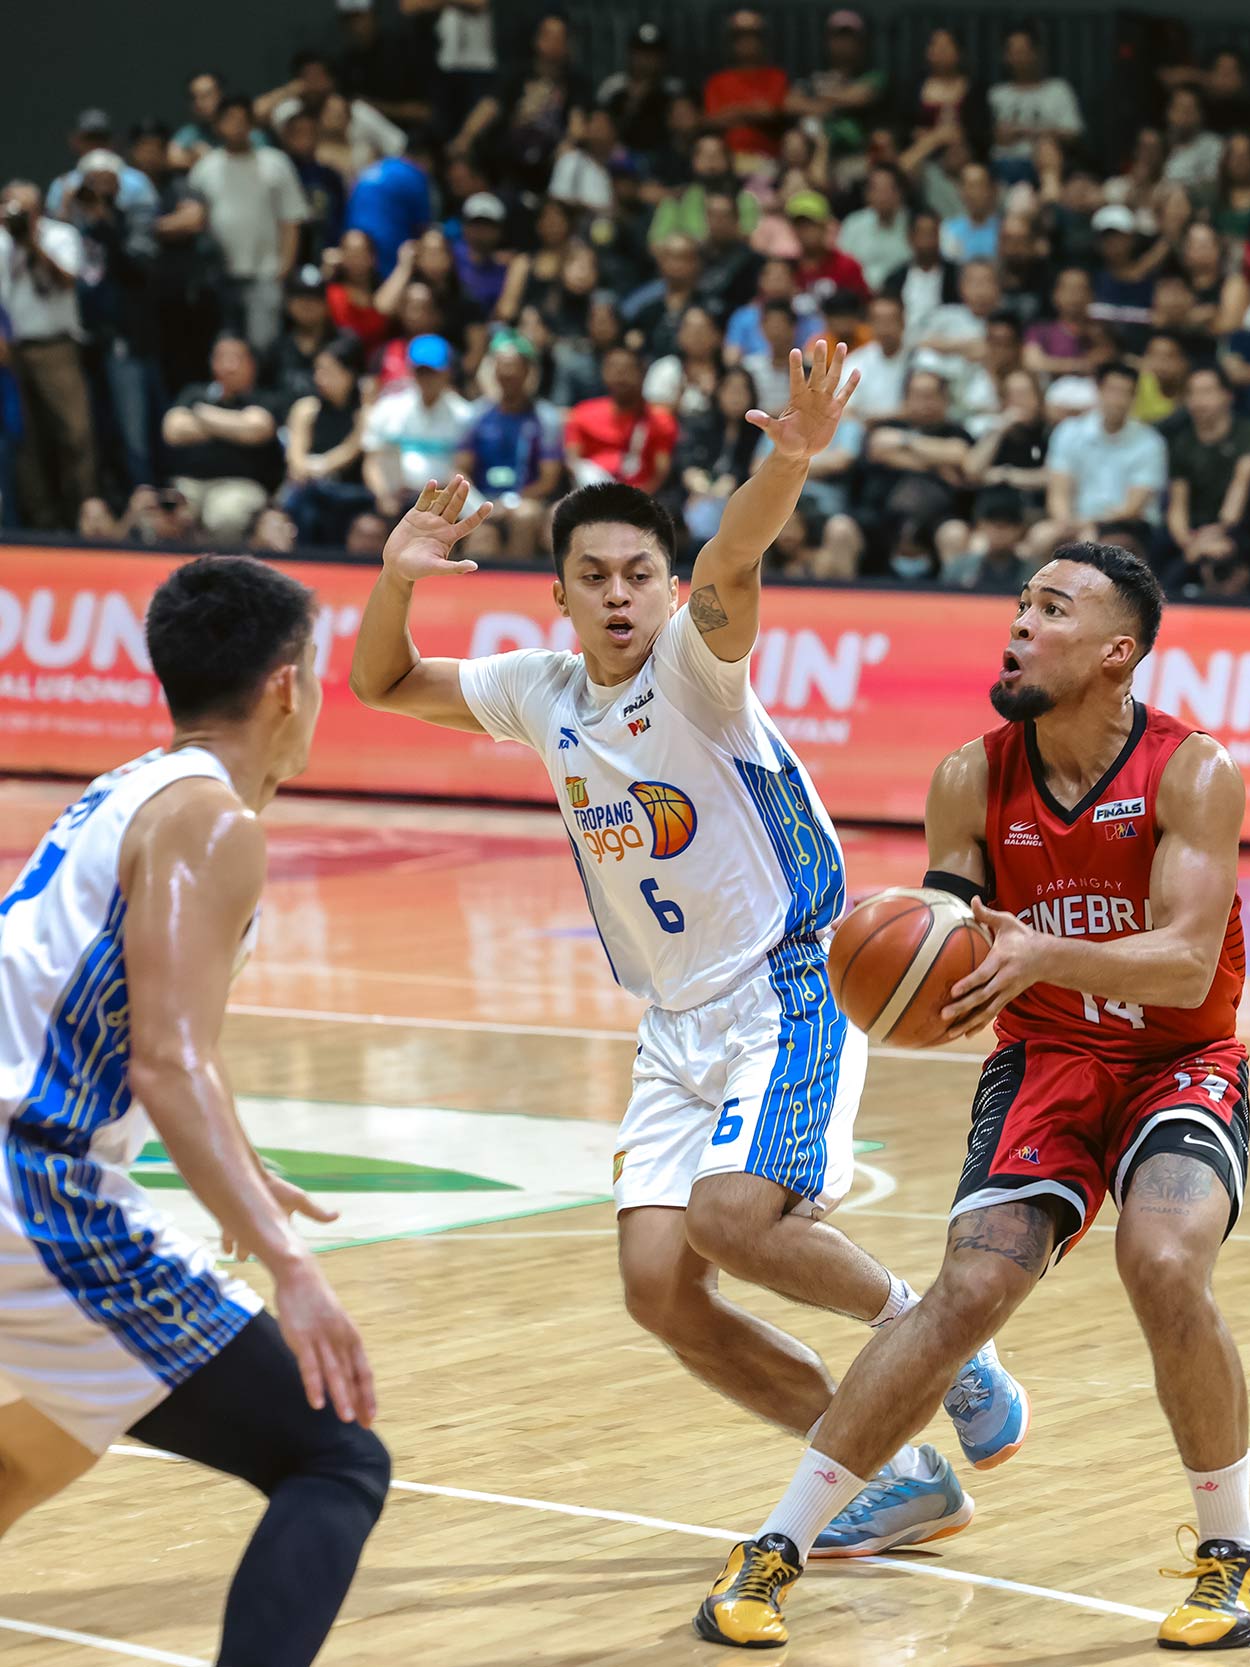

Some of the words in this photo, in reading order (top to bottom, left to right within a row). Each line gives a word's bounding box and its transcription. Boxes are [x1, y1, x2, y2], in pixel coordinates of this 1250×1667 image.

[623, 688, 654, 717] FINALS
[574, 800, 634, 832] TROPANG
[1096, 802, 1142, 821] FINALS
[583, 824, 644, 864] giga
[1004, 839, 1043, 847] BALANCE
[1008, 832, 1040, 840] WORLD
[1036, 878, 1122, 896] BARANGAY
[639, 877, 686, 934] 6
[1080, 990, 1146, 1030] 14
[1173, 1071, 1230, 1104] 14
[711, 1096, 744, 1147] 6
